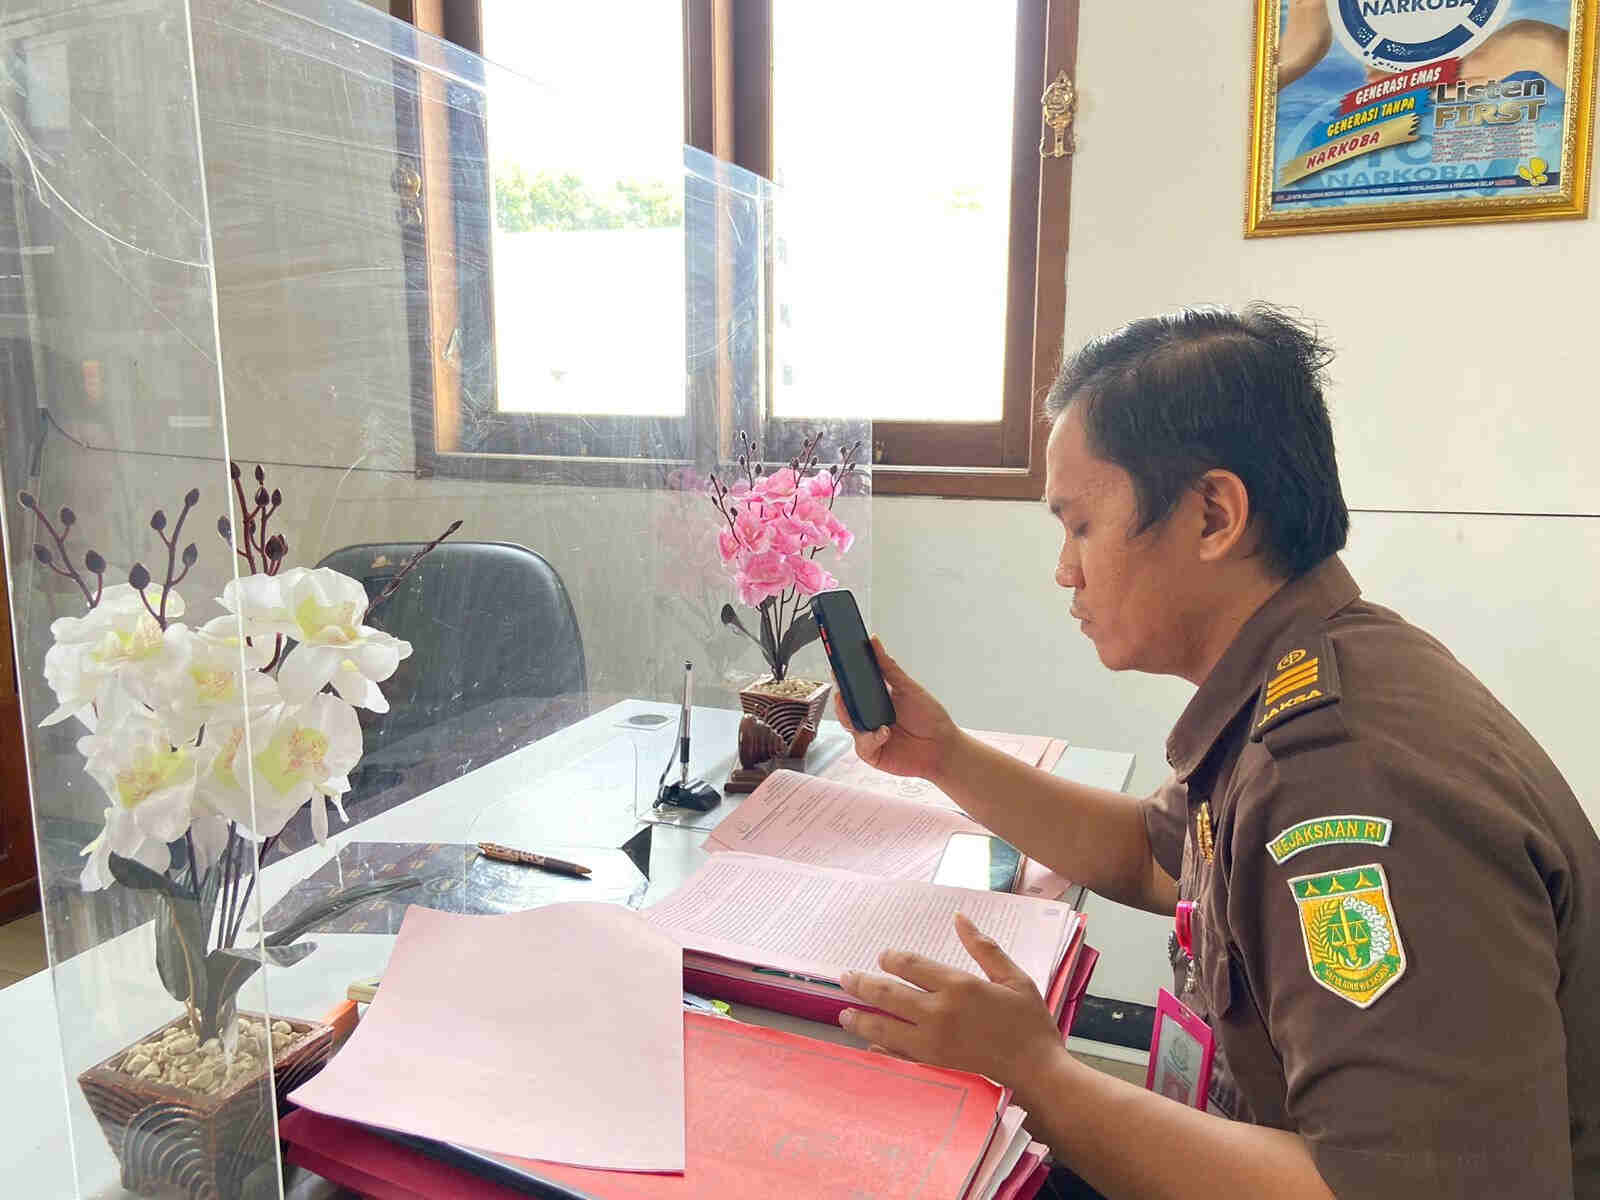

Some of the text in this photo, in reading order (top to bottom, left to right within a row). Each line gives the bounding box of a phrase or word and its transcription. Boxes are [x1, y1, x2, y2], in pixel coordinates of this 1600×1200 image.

[1355, 67, 1442, 105] GENERASI EMAS
[1435, 79, 1545, 104] Listen
[1327, 107, 1379, 137] GENERASI
[1434, 98, 1546, 129] FIRST
[1305, 131, 1381, 169] NARKOBA
[1323, 164, 1480, 188] NARKOBA
[1271, 820, 1382, 858] KEJAKSAAN RI
